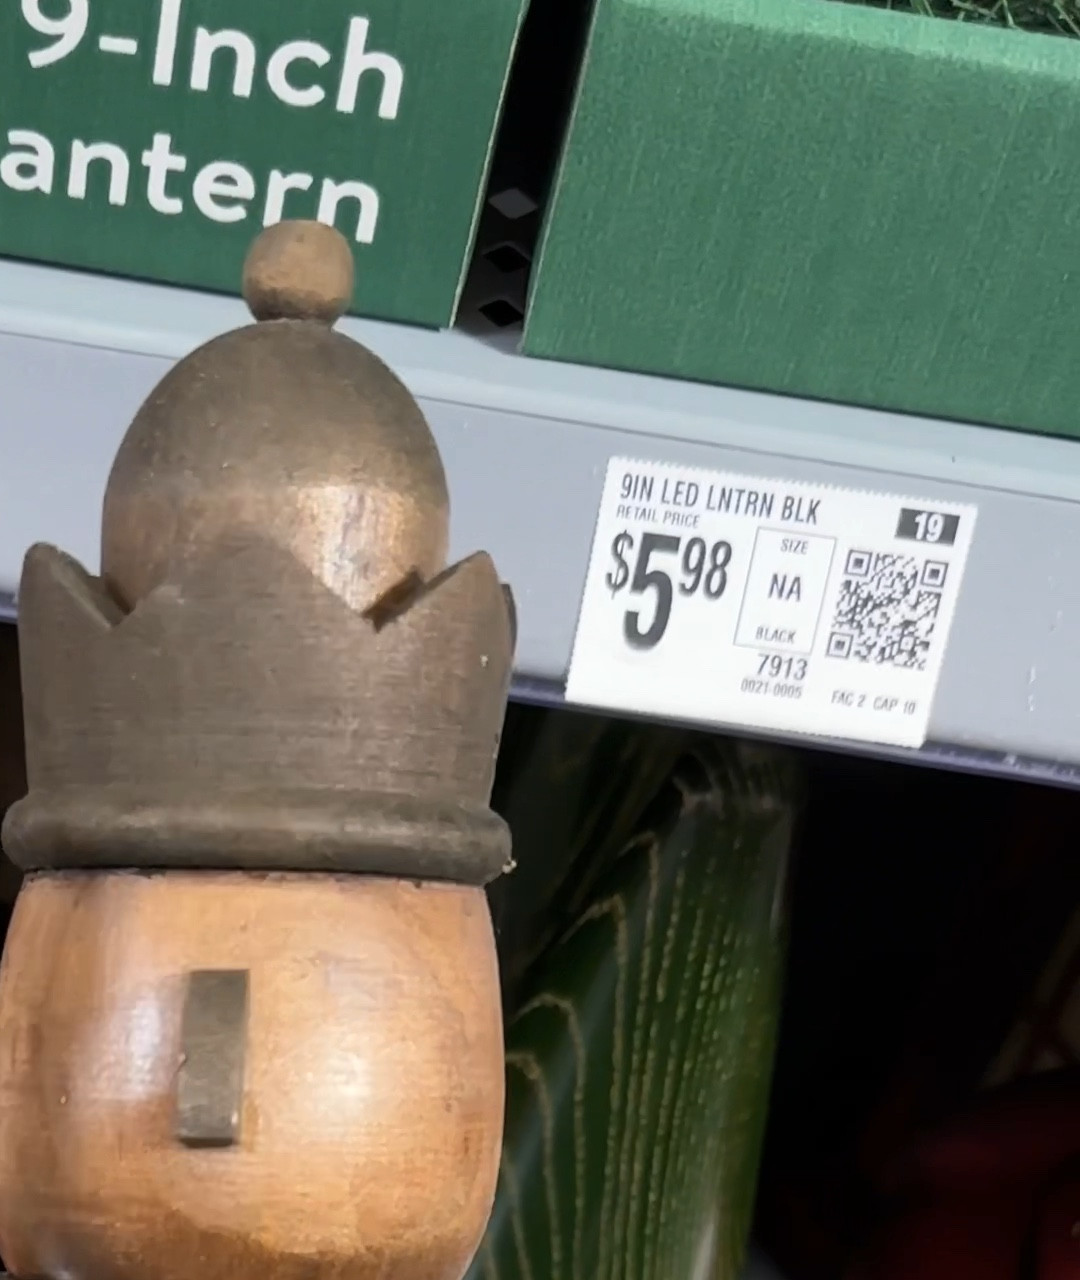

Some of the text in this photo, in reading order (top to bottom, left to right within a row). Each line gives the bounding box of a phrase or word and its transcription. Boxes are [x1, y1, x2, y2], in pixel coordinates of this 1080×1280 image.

[24, 0, 404, 119] 9-Inch
[620, 473, 822, 526] 9IN LED LNTRN BLK
[616, 504, 701, 530] RETAIL PRICE
[913, 511, 945, 543] 19
[780, 537, 809, 555] SIZE
[768, 572, 802, 602] NA
[755, 625, 797, 644] BLACK
[757, 653, 809, 681] 7913
[831, 690, 854, 707] FAC
[857, 693, 867, 708] 2
[873, 696, 898, 712] CAP
